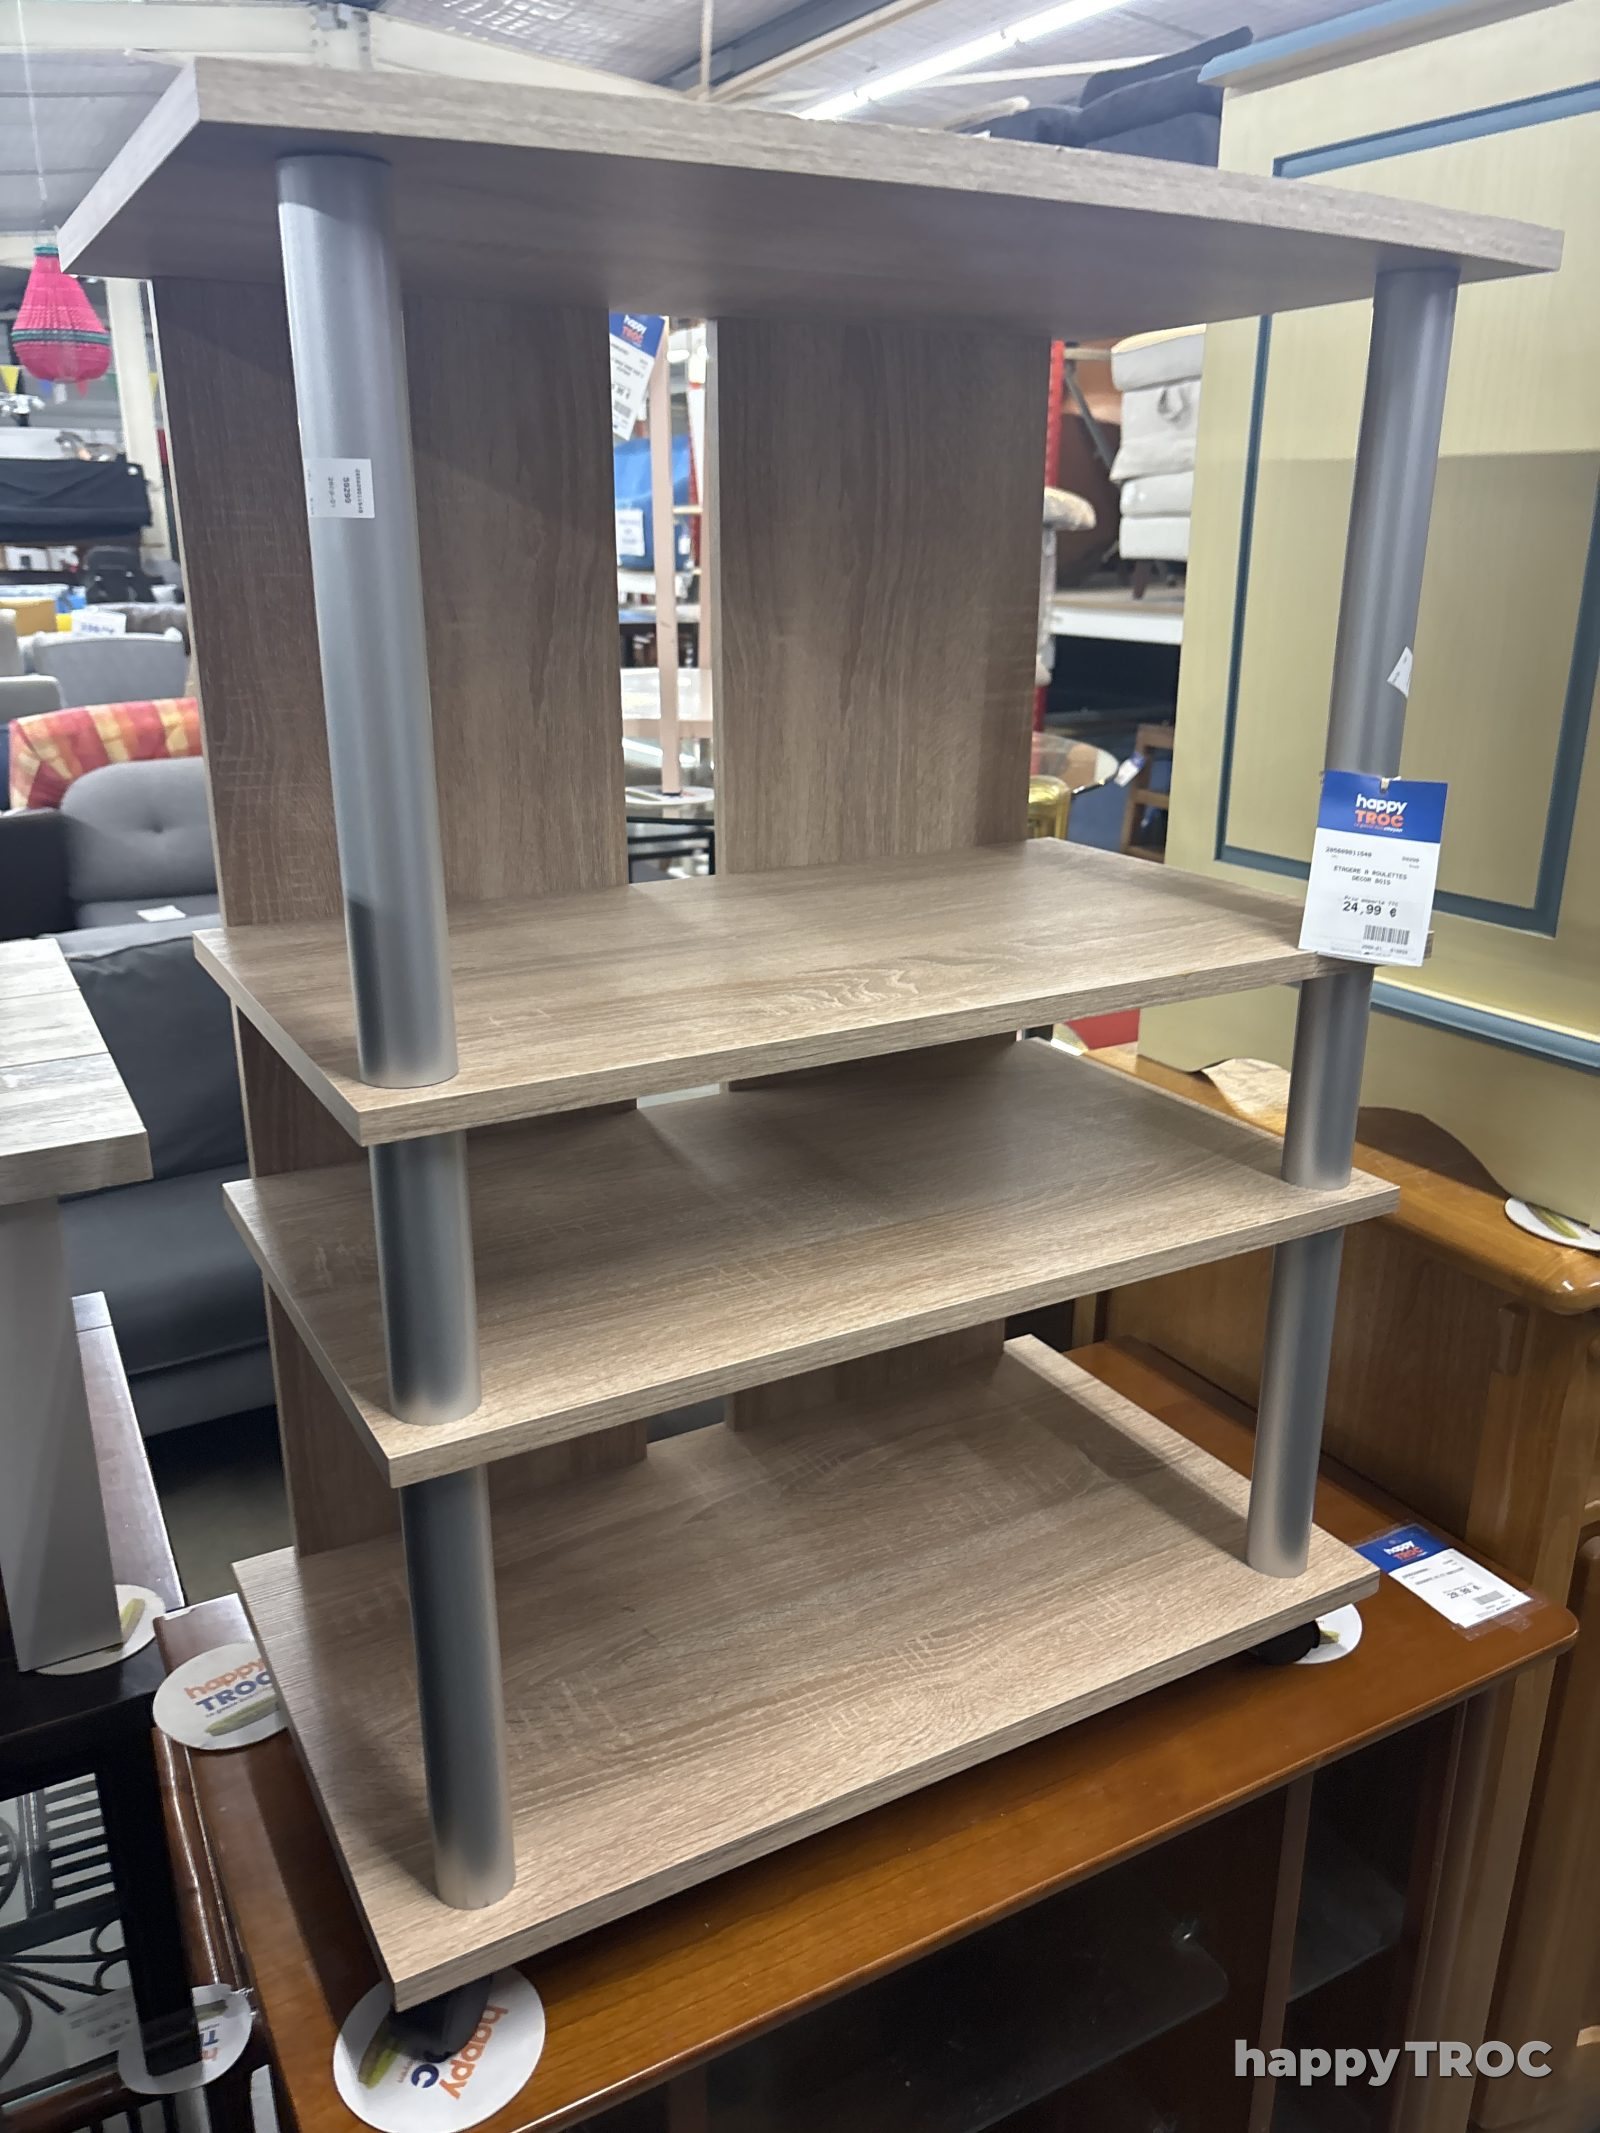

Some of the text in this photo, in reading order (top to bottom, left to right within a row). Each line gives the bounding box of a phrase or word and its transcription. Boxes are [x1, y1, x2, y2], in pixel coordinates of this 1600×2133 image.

[1355, 793, 1408, 816] happy
[1354, 809, 1404, 827] TROC
[1371, 869, 1407, 881] ROULETTES
[1374, 877, 1391, 886] BOIS
[1342, 900, 1397, 918] 24,99 €
[1383, 1540, 1416, 1556] happy
[439, 2004, 509, 2101] happy
